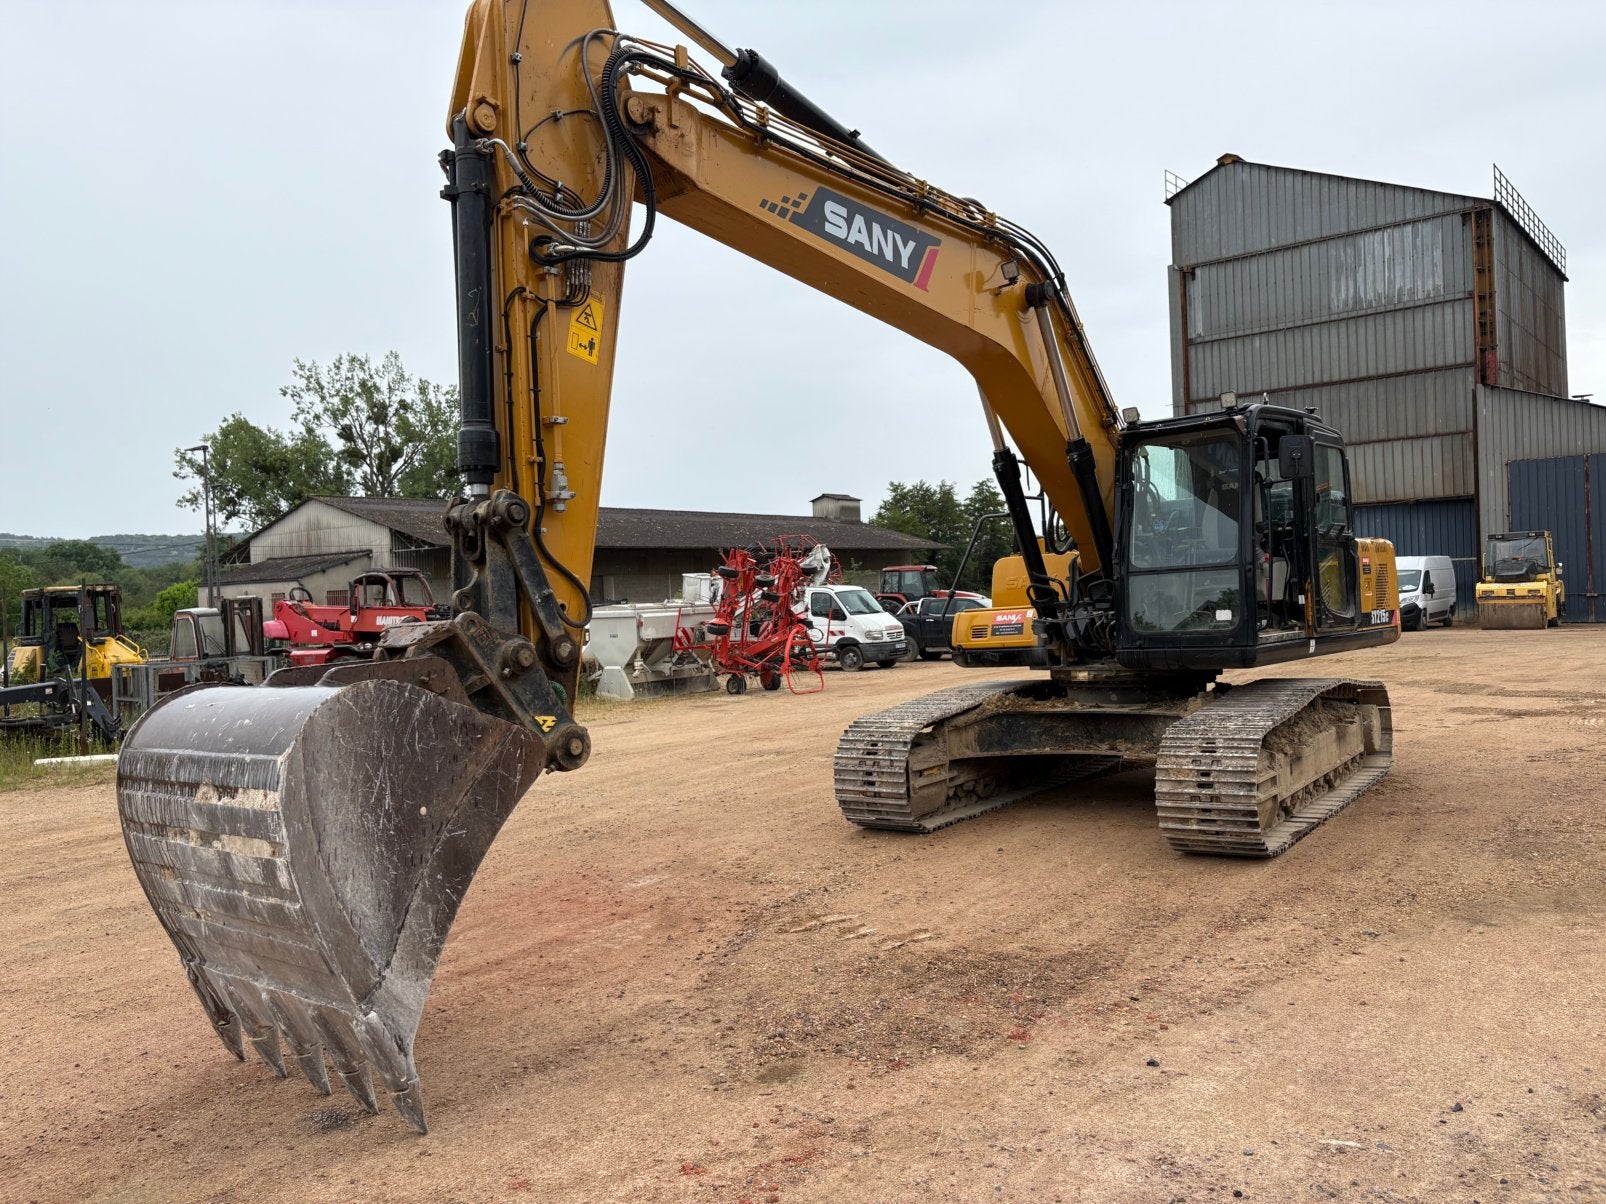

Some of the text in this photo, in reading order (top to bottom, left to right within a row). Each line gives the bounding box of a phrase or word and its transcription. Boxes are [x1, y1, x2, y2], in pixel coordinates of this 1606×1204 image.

[823, 200, 917, 270] SANY
[1222, 482, 1239, 490] SAN
[1007, 576, 1028, 590] SA
